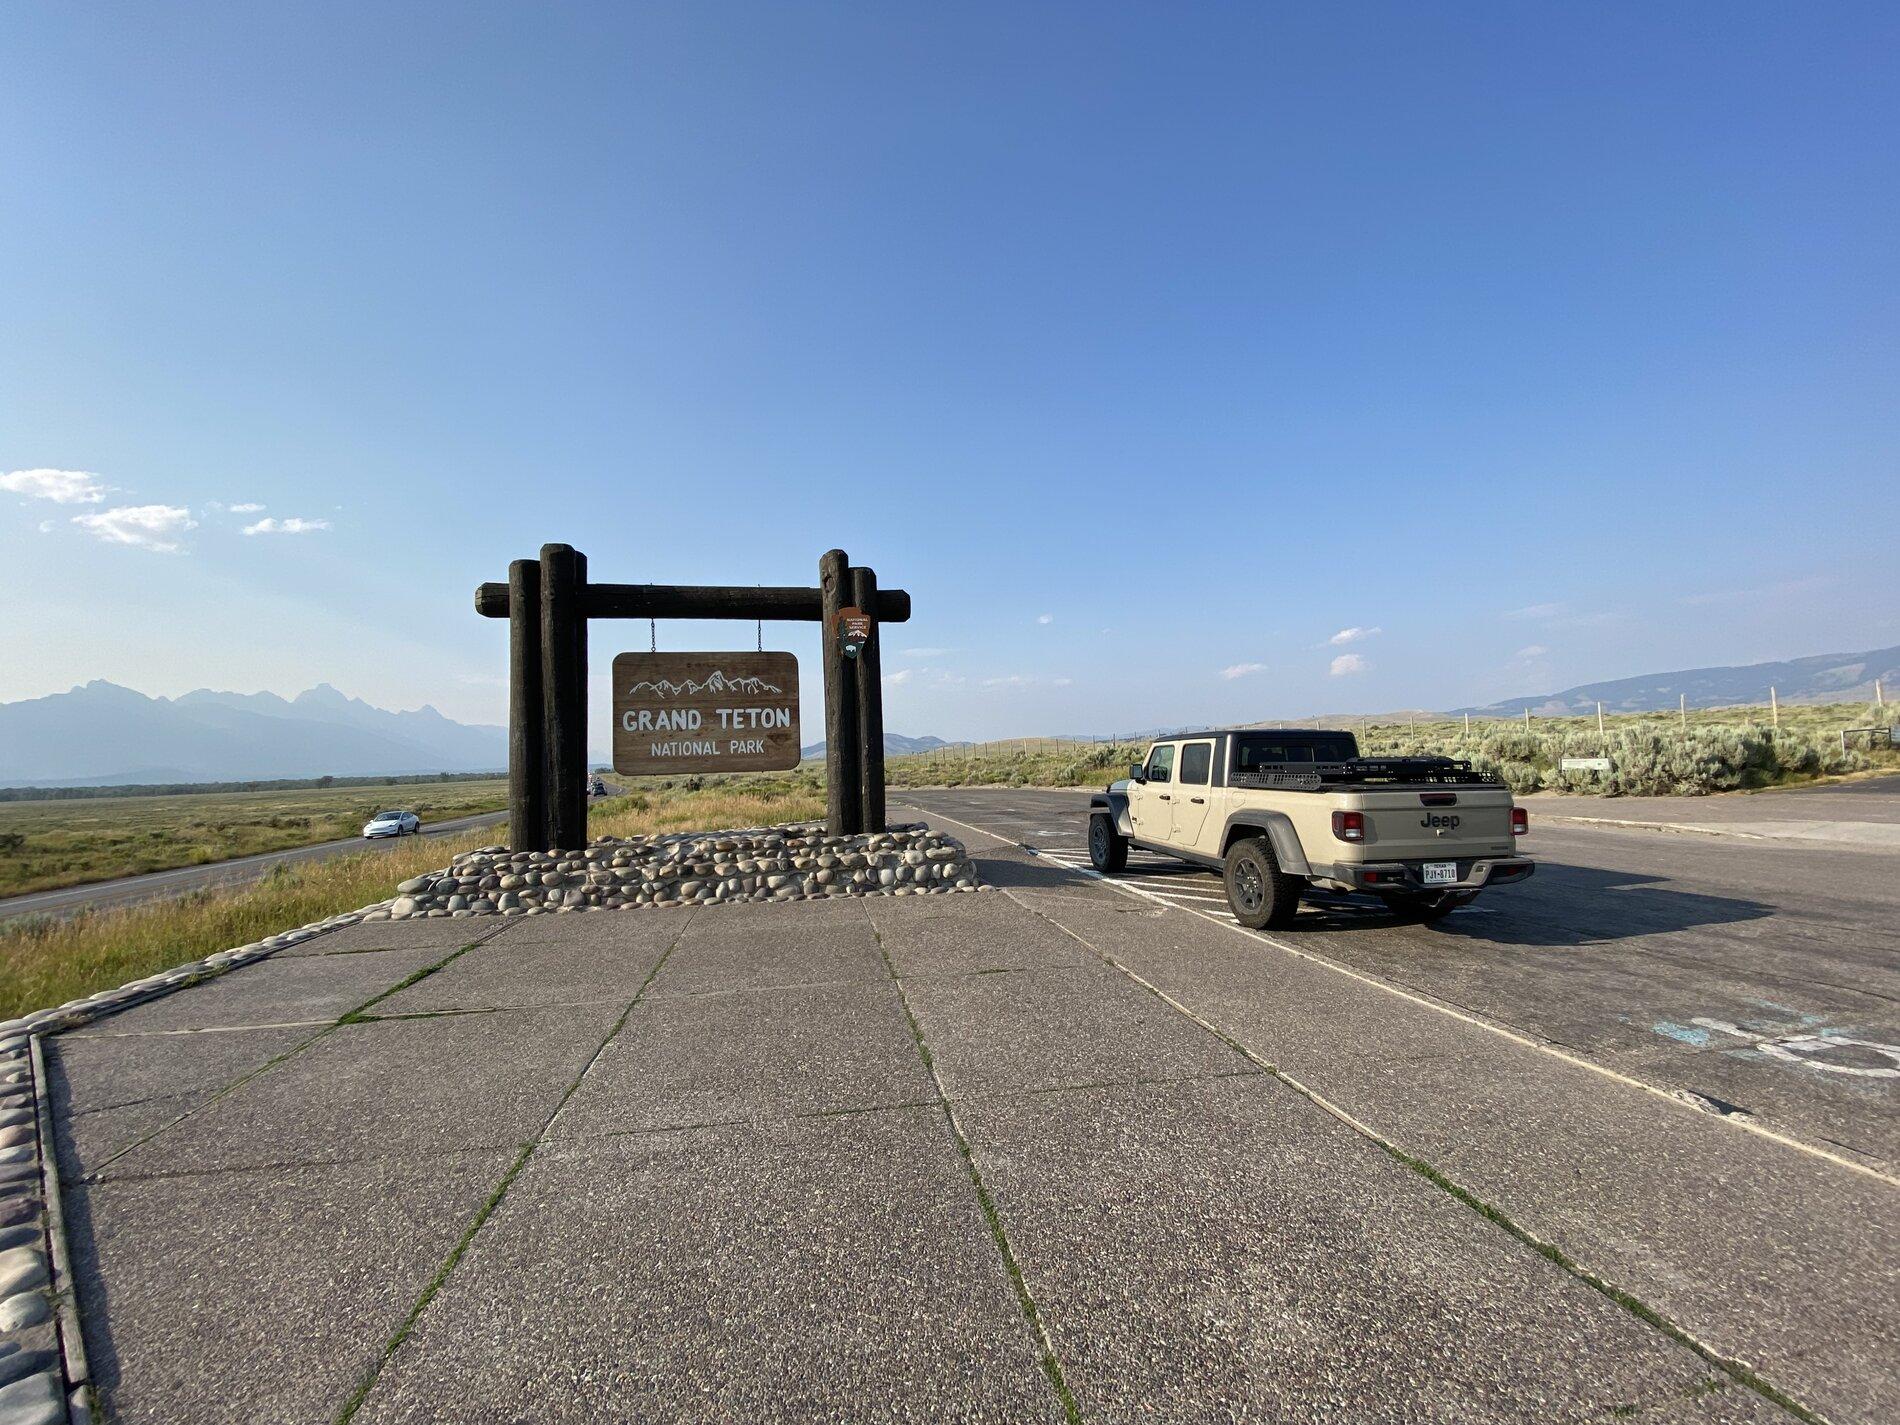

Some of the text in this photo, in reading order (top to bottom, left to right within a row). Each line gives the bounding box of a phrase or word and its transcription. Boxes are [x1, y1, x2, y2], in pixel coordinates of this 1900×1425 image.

[622, 707, 791, 732] GRAND TETON
[651, 739, 765, 757] NATIONAL PARK
[1420, 812, 1460, 830] Jeep
